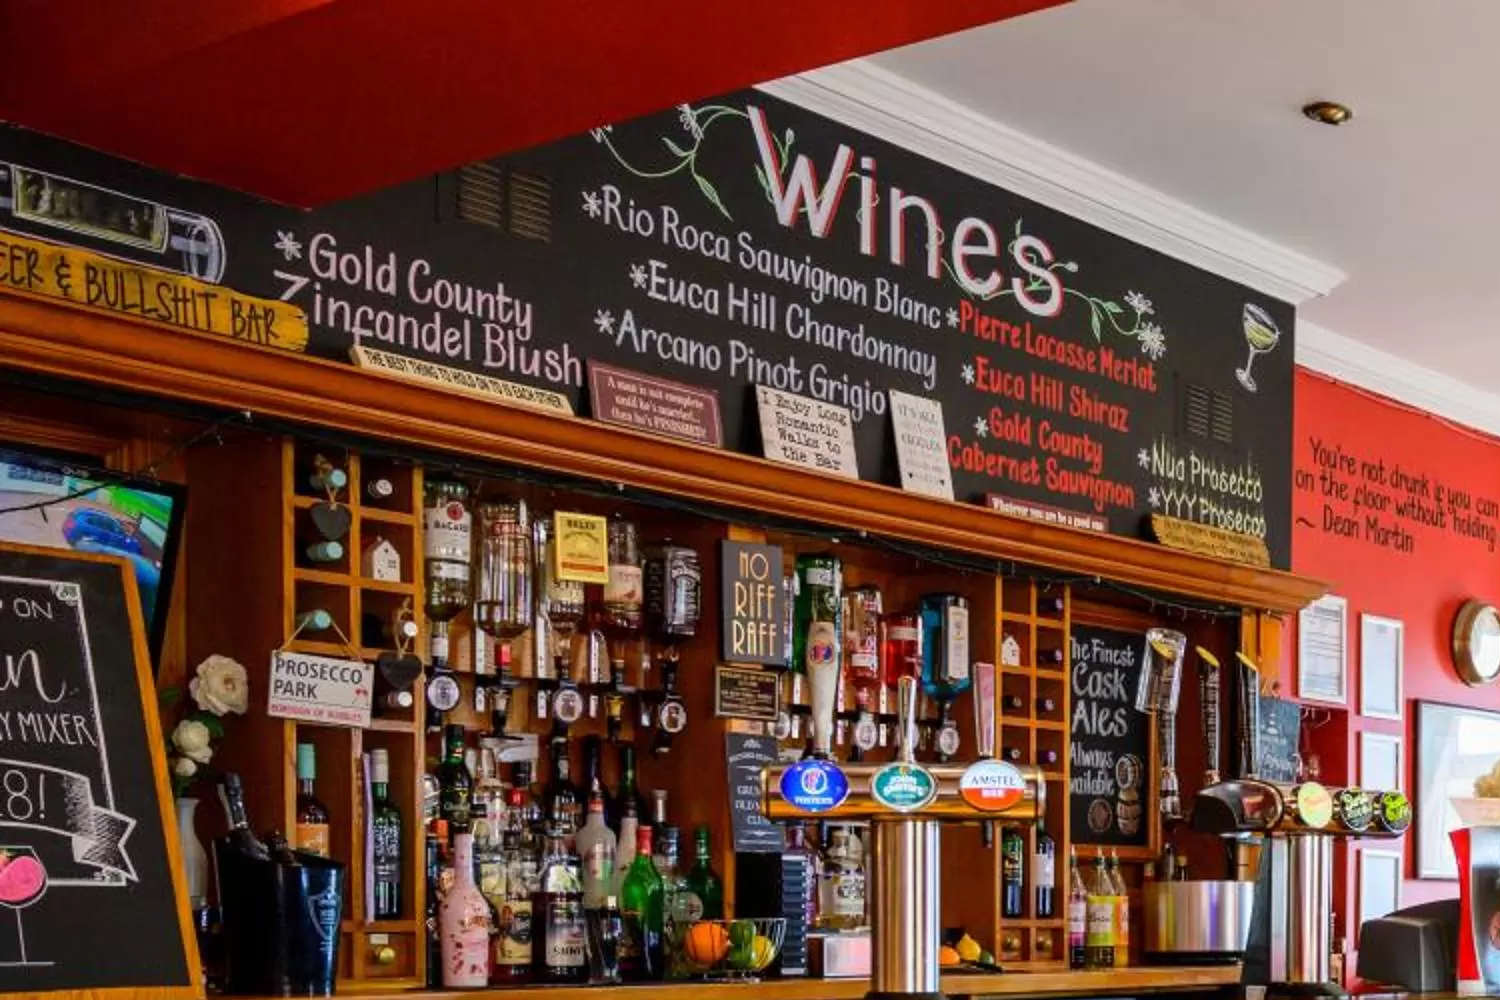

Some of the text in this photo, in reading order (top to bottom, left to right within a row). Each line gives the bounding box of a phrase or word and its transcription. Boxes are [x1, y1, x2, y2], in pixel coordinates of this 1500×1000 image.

[747, 105, 1064, 317] Wines
[602, 184, 942, 330] Rio Roca Sauvignon Blanc
[54, 255, 72, 297] &
[85, 261, 218, 332] BULLSHIT
[229, 297, 280, 346] BAR
[308, 232, 533, 341] Gold County
[273, 269, 583, 387] Zinfandel Blush
[647, 259, 938, 390] Euca Hill Chardonnay
[959, 299, 1157, 393] Pierre Lacasse Merlot
[615, 309, 886, 423] Arcano Pinot Grigio
[975, 356, 1130, 433] Euca Hill Shiraz
[775, 411, 839, 438] Romantic
[778, 427, 841, 455] Walks to
[988, 407, 1032, 446] Gold
[1038, 420, 1104, 474] County
[781, 445, 841, 470] the Bar
[948, 436, 1041, 485] Cabernet
[1045, 457, 1136, 511] Sauvignon
[1189, 452, 1263, 503] Prosecco
[1309, 435, 1357, 476] You're
[1361, 456, 1387, 485] not
[1389, 464, 1430, 497] drunk
[1447, 486, 1471, 515] you
[1475, 497, 1499, 519] can
[1295, 469, 1314, 491] on
[1319, 469, 1348, 502] the
[1353, 482, 1392, 516] floor
[1395, 494, 1447, 529] without
[1450, 511, 1497, 552] holding
[1323, 504, 1414, 552] Dean Martin
[739, 550, 769, 581] NO
[13, 597, 53, 619] ON
[734, 581, 776, 619] RIFF
[732, 619, 777, 657] RAFF
[1091, 637, 1135, 668] Finest
[273, 679, 318, 699] PARK
[275, 656, 363, 685] PROSECCO
[1071, 661, 1128, 702] Cask
[17, 711, 98, 747] MIXER
[1071, 699, 1128, 737] Ales
[971, 775, 1017, 787] AMSTEL
